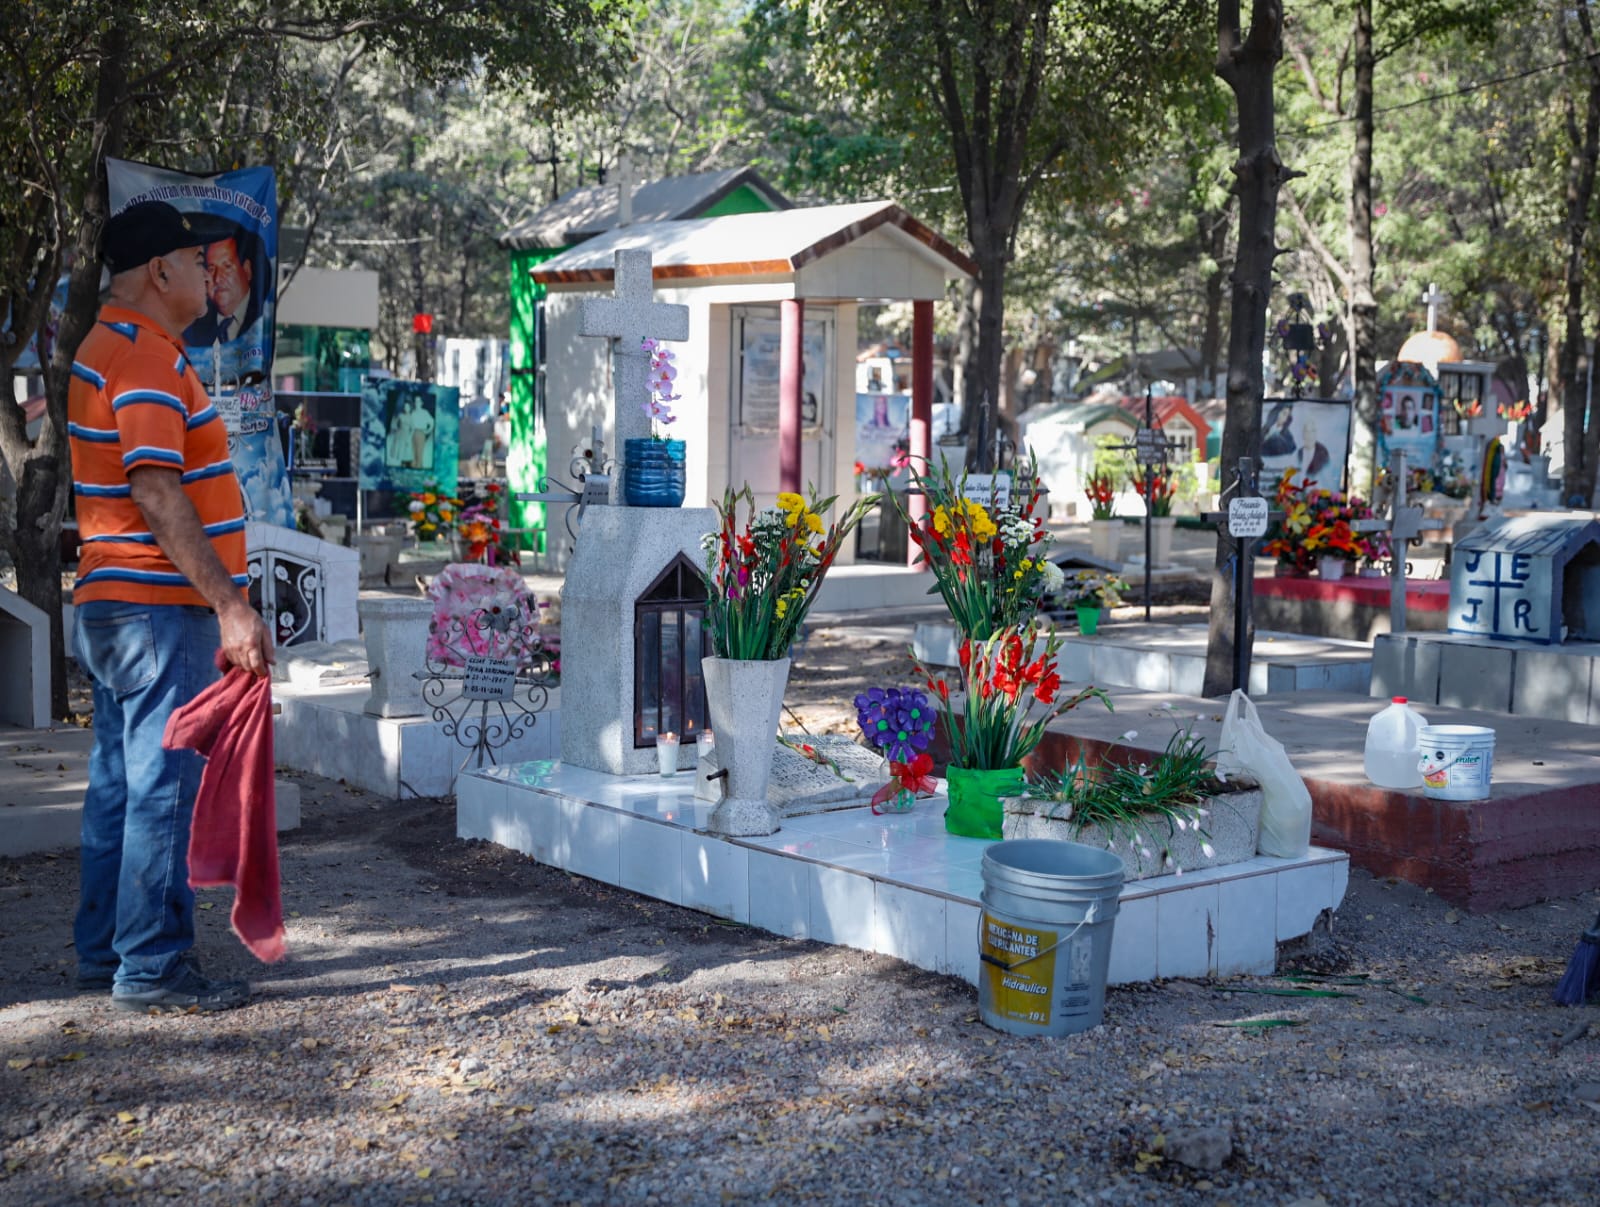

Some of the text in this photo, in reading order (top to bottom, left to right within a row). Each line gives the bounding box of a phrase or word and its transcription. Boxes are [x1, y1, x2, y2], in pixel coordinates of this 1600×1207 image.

[180, 184, 191, 198] en
[192, 184, 232, 204] nuestros
[1513, 598, 1540, 633] R
[1026, 934, 1038, 946] DE
